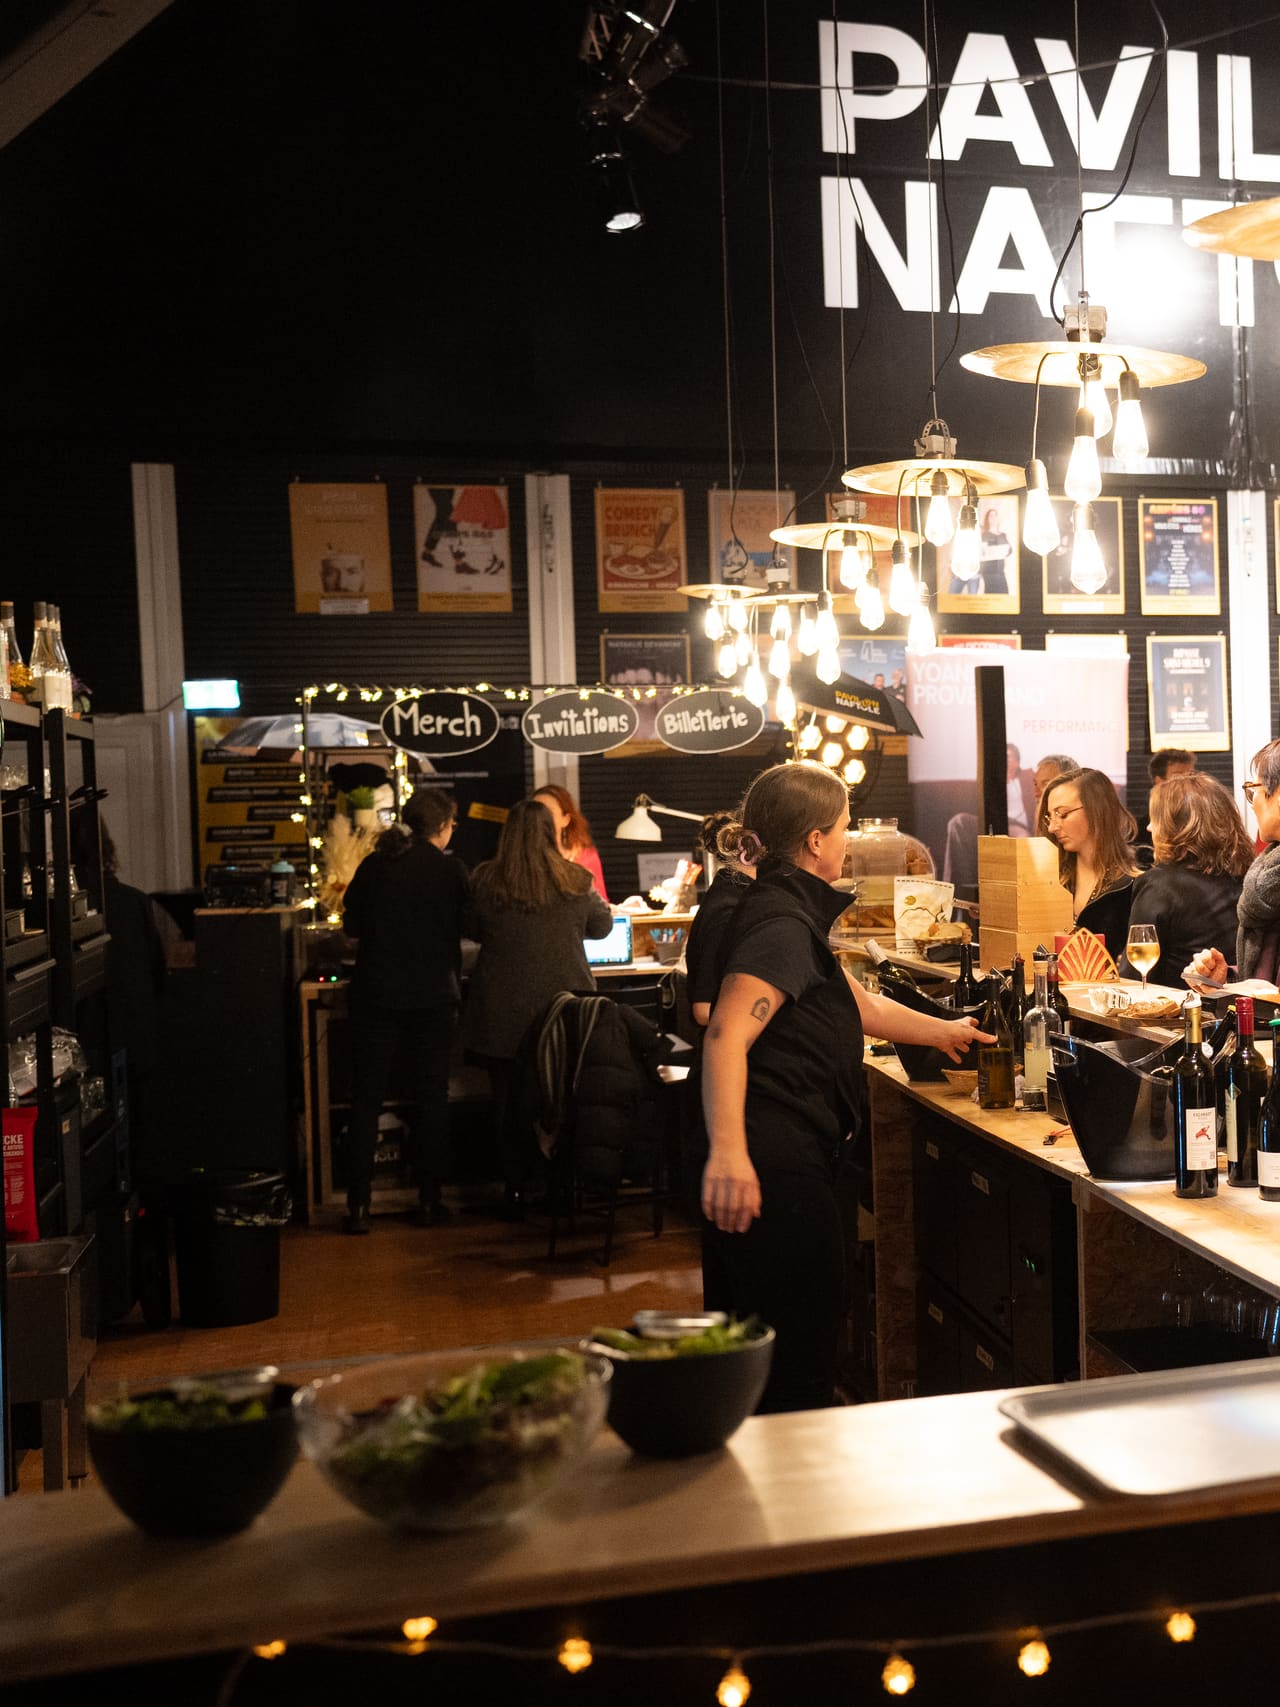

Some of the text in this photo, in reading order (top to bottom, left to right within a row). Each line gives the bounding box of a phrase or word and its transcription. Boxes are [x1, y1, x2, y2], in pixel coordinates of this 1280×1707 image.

[604, 506, 658, 521] COMEDY
[391, 699, 483, 738] Merch
[528, 707, 629, 740] Invitations
[663, 706, 751, 735] Billetterie
[3, 1134, 24, 1145] CKE
